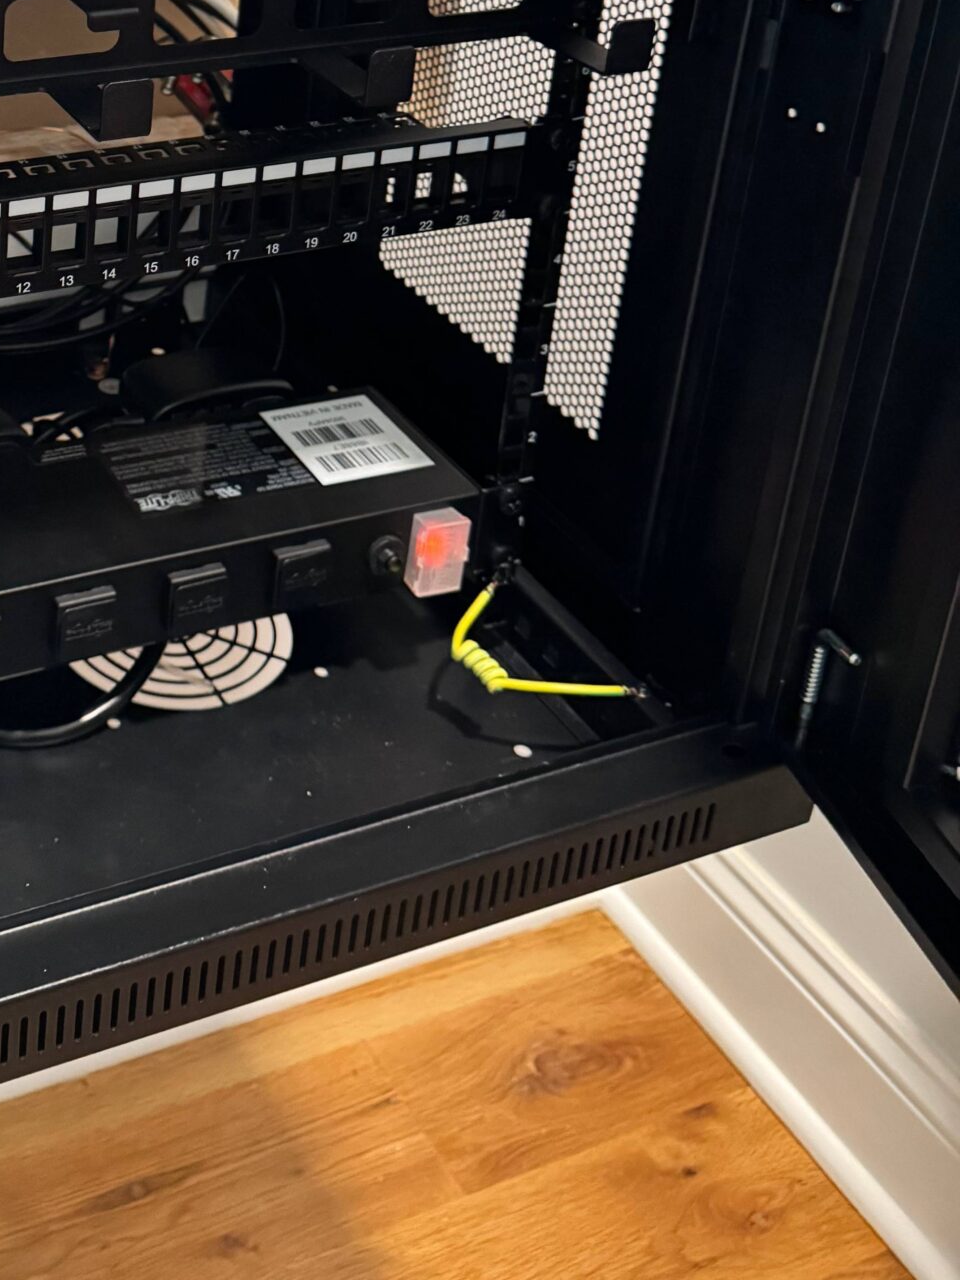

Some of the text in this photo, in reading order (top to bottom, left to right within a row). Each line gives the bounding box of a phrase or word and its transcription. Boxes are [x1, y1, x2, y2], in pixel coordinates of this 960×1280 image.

[382, 226, 395, 237] 21
[419, 220, 433, 232] 22
[304, 237, 319, 249] 19
[342, 231, 357, 243] 20
[226, 248, 239, 261] 17
[266, 243, 280, 255] 18
[144, 261, 158, 274] 15
[185, 255, 199, 268] 16
[102, 268, 116, 280] 14
[59, 275, 74, 288] 13
[16, 282, 31, 294] 12
